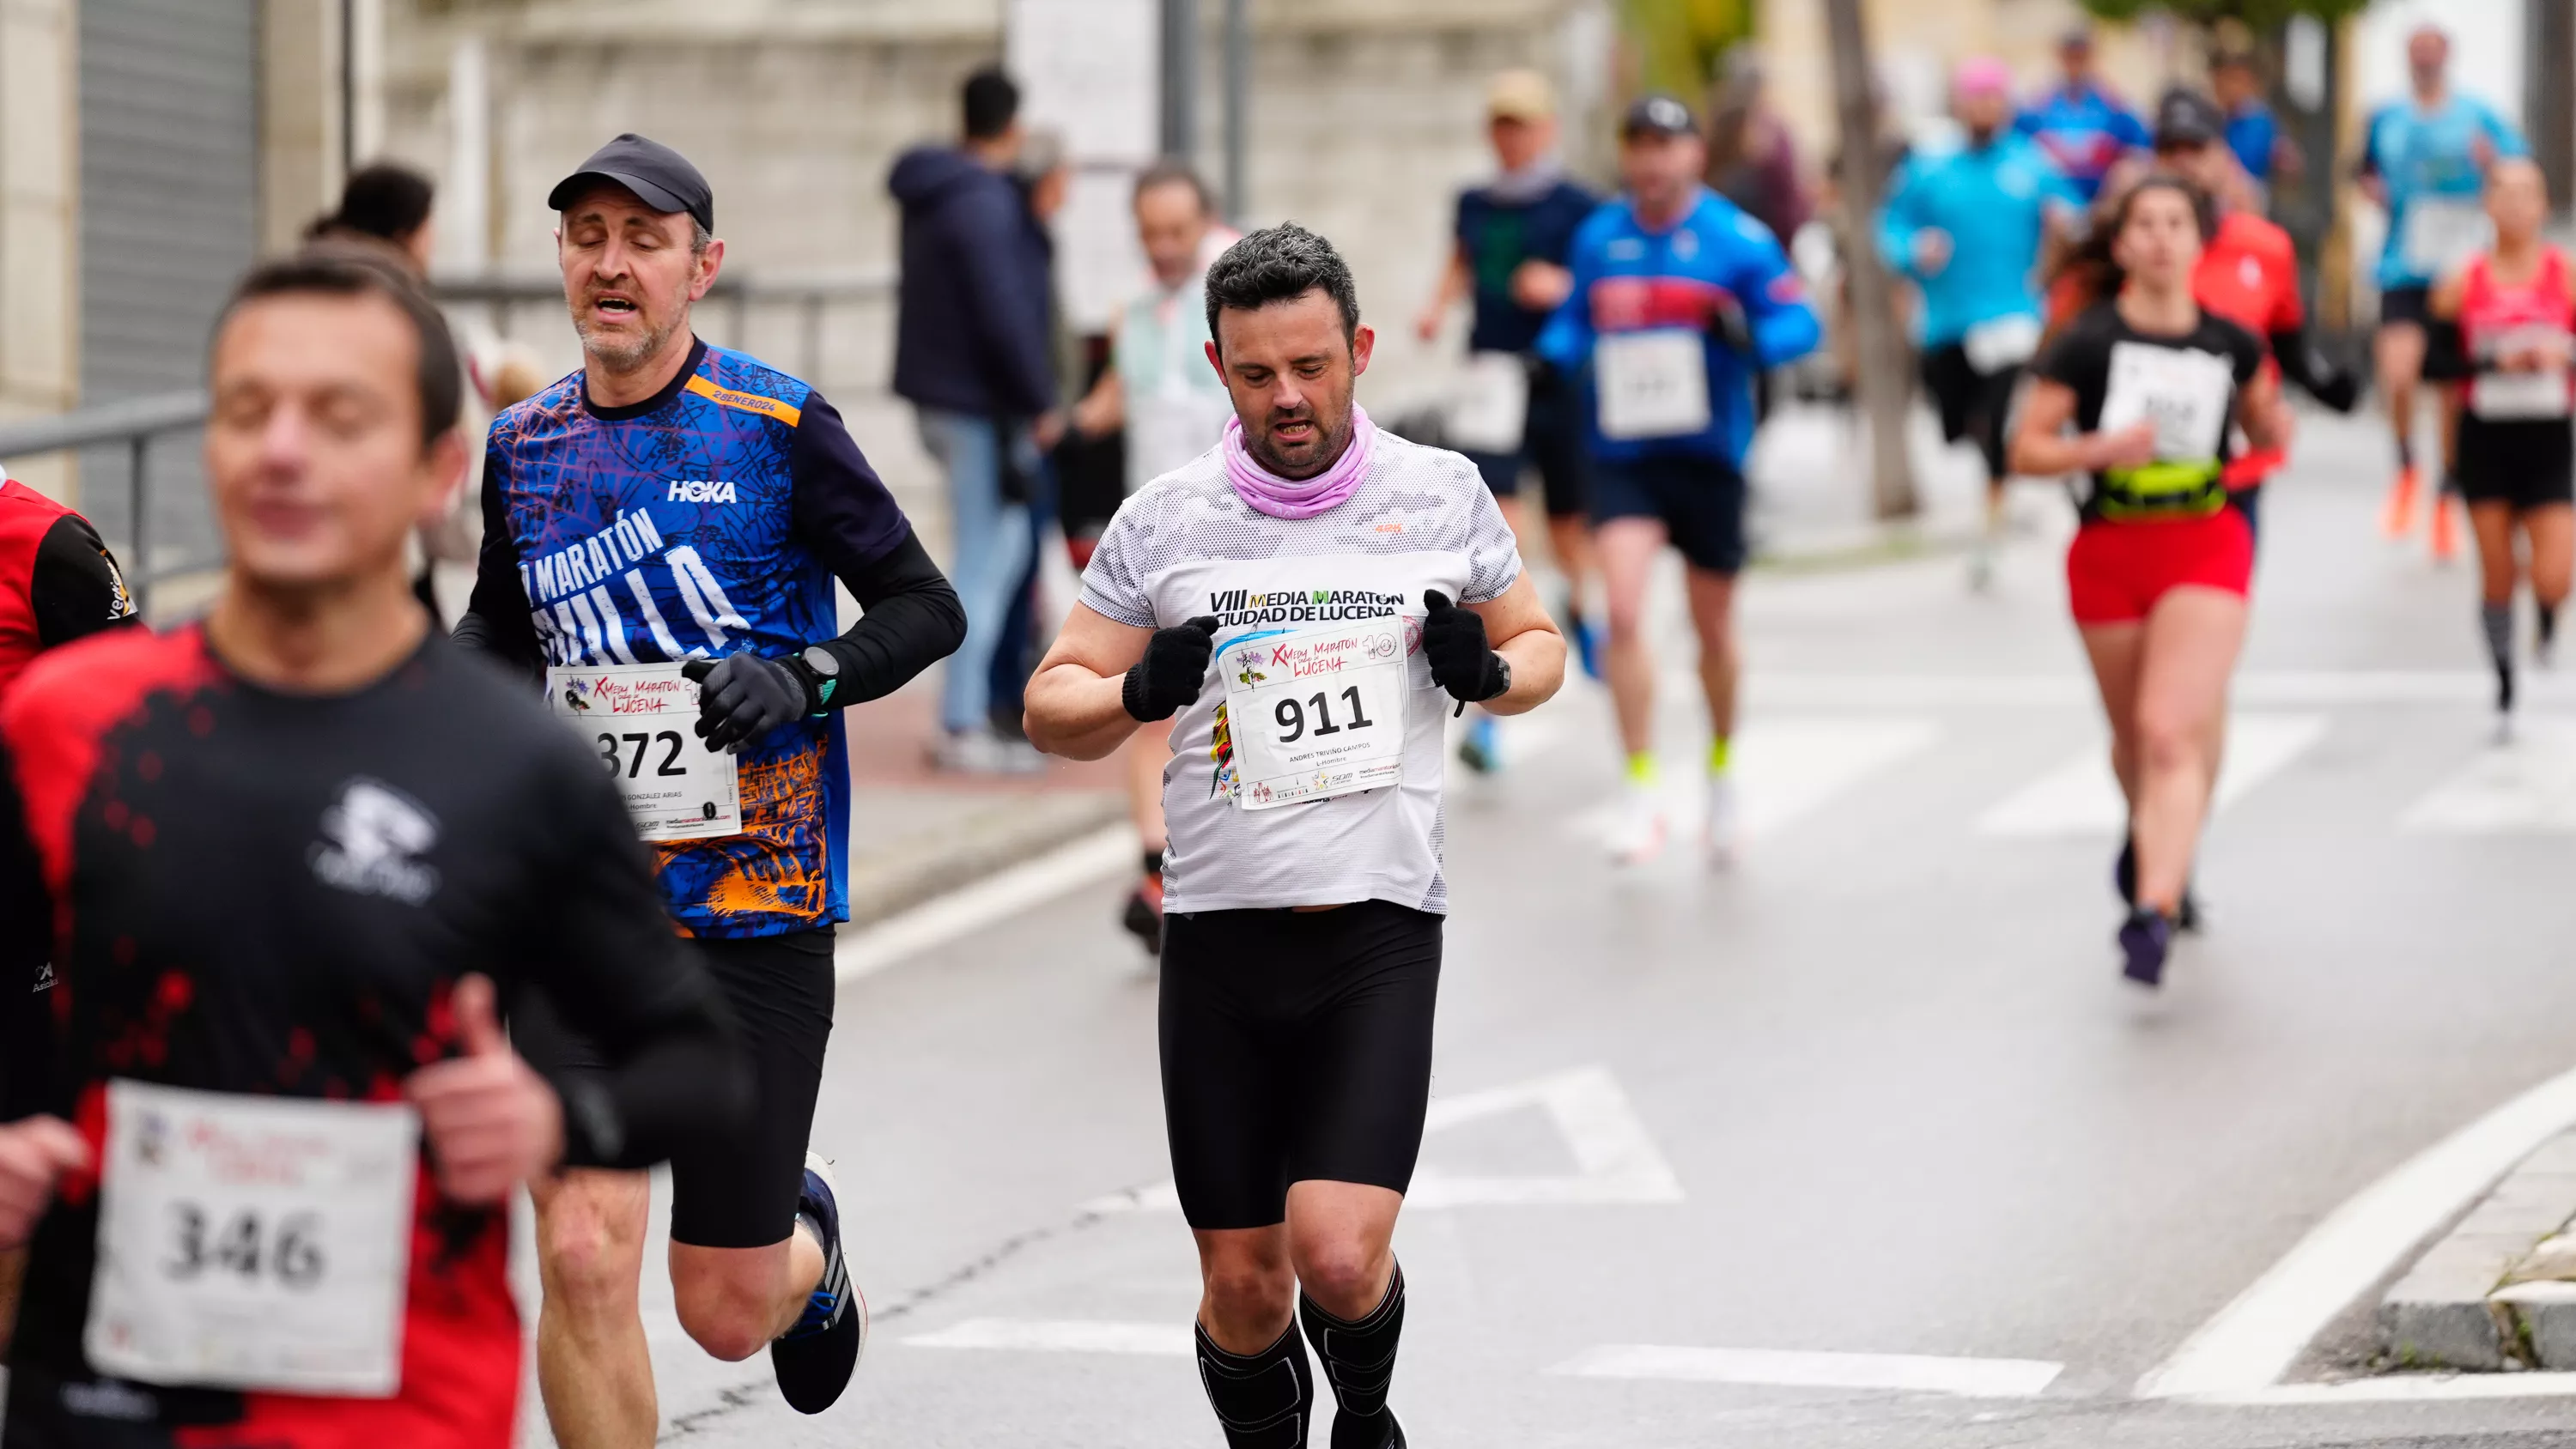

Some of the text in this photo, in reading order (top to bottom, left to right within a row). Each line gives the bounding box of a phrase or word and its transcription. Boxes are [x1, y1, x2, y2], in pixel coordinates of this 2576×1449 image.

[667, 480, 737, 504] HOKA
[535, 507, 665, 603] MARATÓN
[1211, 590, 1248, 612] VIII
[1249, 591, 1309, 609] MEDIA
[1215, 606, 1396, 627] CIUDAD DE LUCENA
[1293, 657, 1348, 677] LUCENA
[612, 697, 671, 713] LUCENA
[1275, 685, 1373, 743] 911
[598, 729, 687, 779] 372
[1289, 743, 1370, 763] ANDRES TRIVIÑO CAMPOS
[1316, 756, 1347, 767] L-Hombre
[167, 1203, 328, 1290] 346
